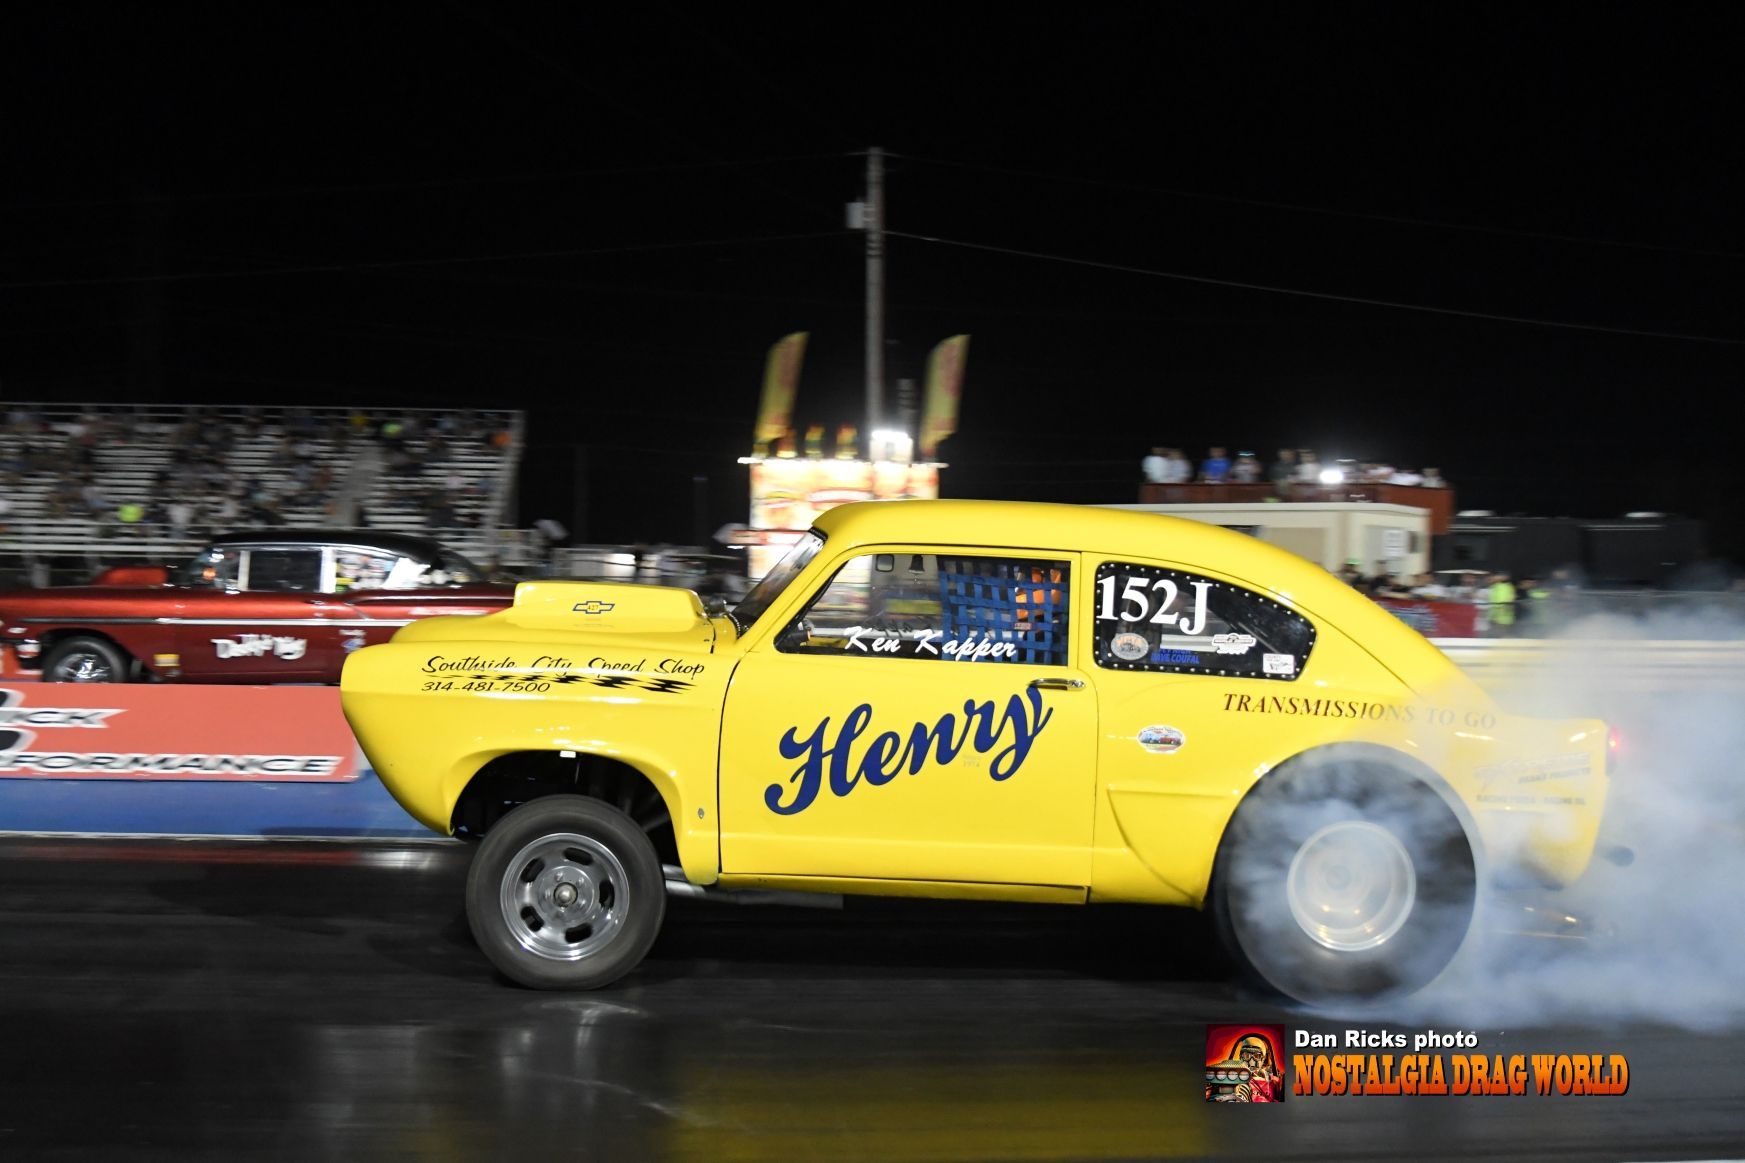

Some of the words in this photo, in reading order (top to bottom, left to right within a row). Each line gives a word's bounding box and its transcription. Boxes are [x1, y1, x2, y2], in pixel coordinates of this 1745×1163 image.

[1096, 575, 1213, 635] 152J
[843, 625, 901, 652] Ken
[914, 628, 1017, 662] Kapper
[421, 655, 518, 673] Southside
[531, 656, 573, 677] City
[654, 658, 705, 680] Shop
[421, 681, 551, 693] 314-481-7500
[1223, 693, 1416, 722] TRANSMISSIONS
[1426, 707, 1456, 726] TO
[1464, 710, 1497, 729] GO
[764, 686, 1053, 815] Henry
